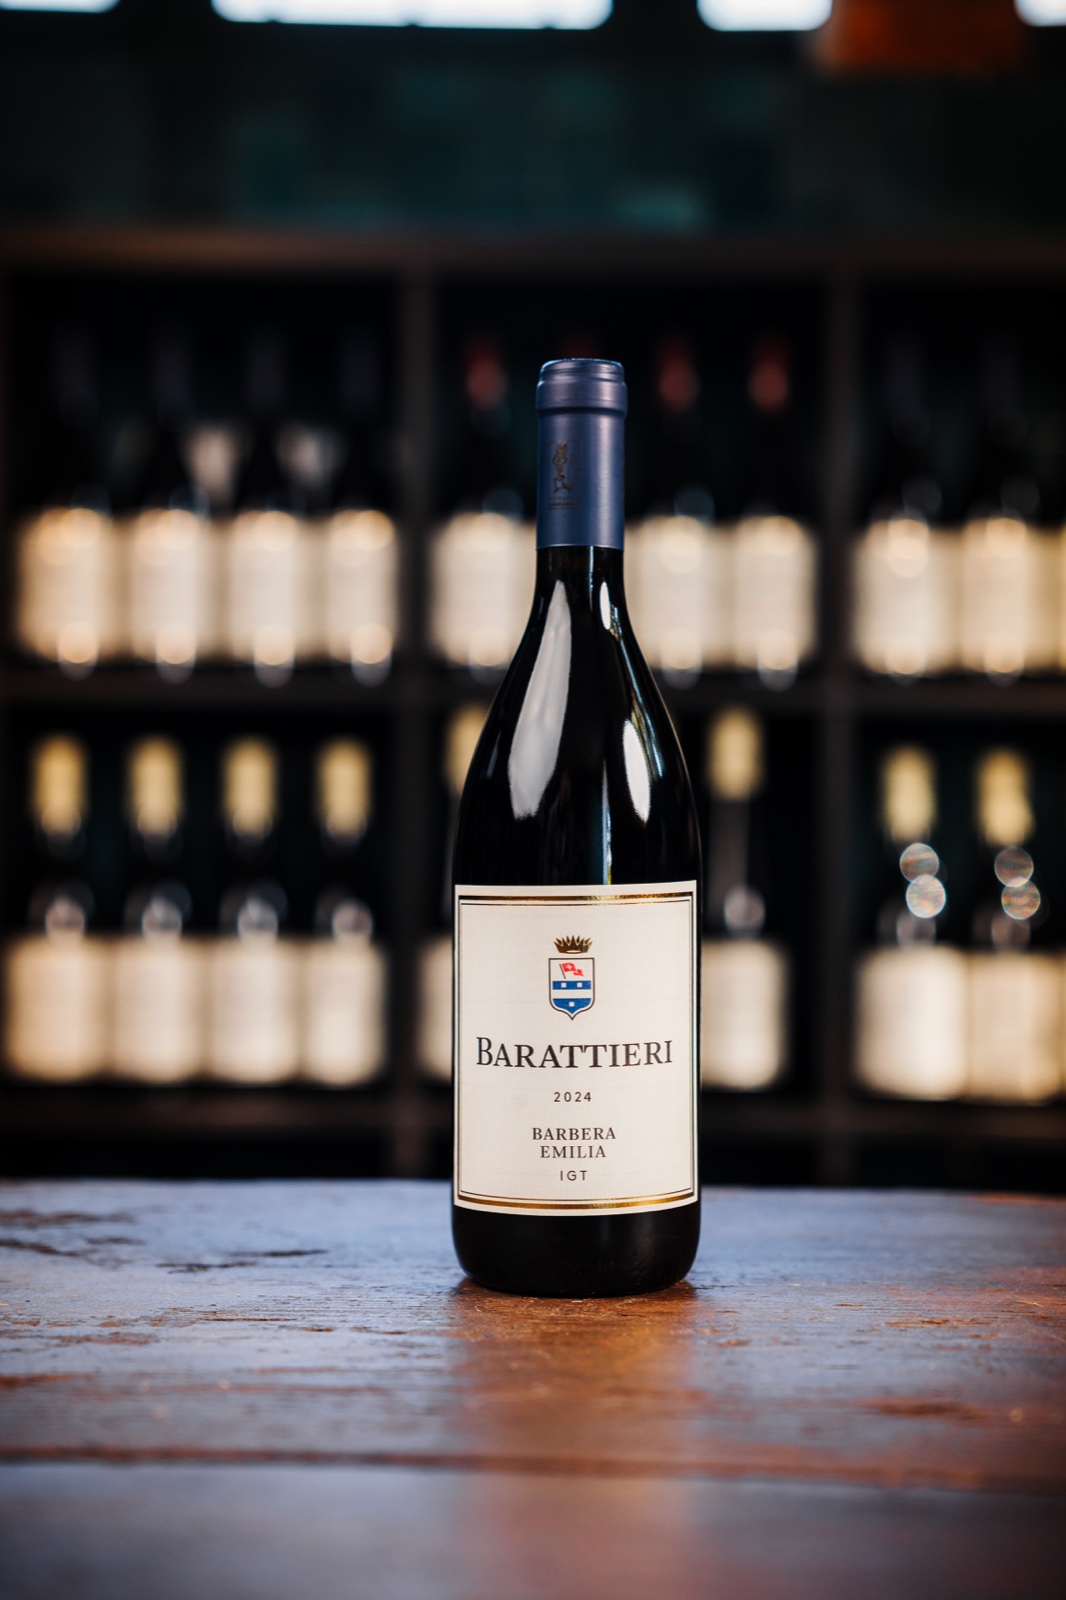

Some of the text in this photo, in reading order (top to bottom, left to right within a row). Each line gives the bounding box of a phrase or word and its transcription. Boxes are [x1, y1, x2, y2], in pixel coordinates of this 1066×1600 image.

[476, 1036, 673, 1069] BARATTIERI
[553, 1091, 592, 1103] 2024
[532, 1127, 616, 1141] BARBERA
[540, 1145, 606, 1159] EMILIA
[560, 1170, 588, 1182] IGT
